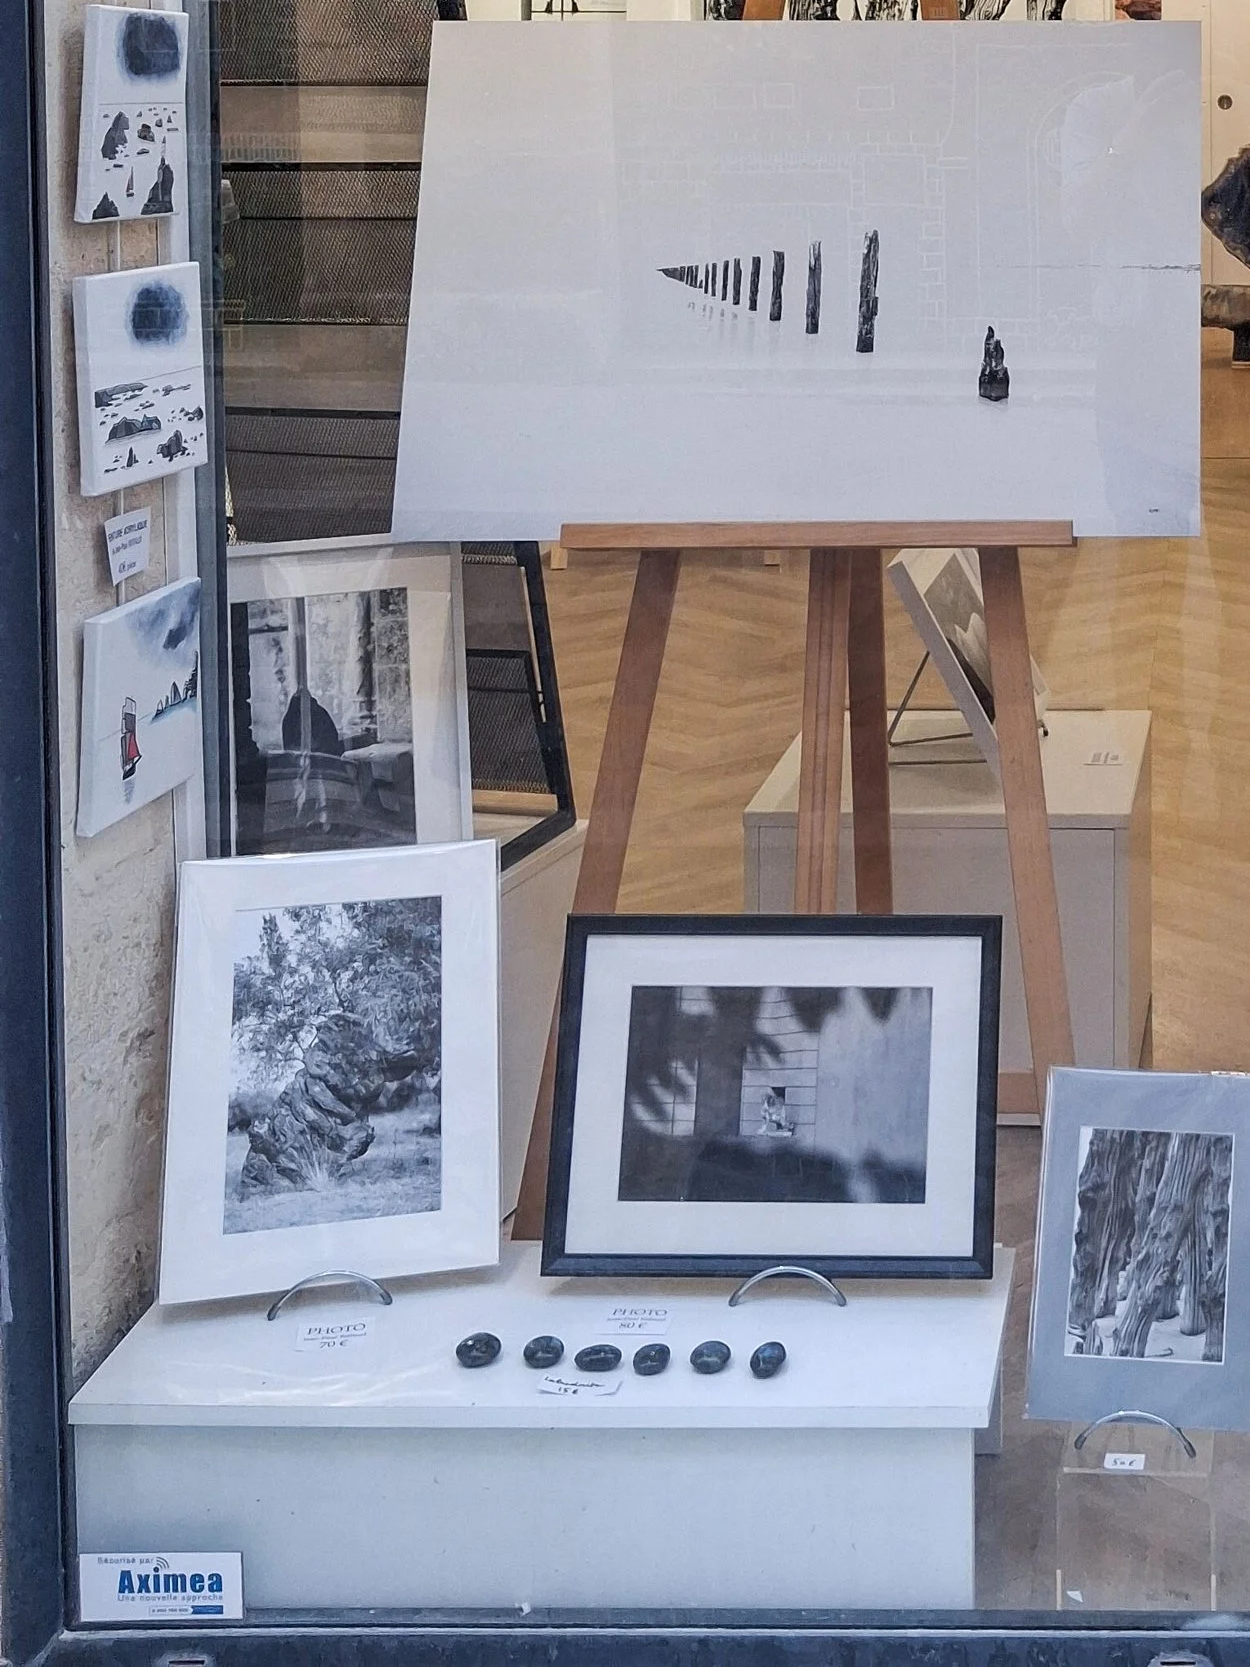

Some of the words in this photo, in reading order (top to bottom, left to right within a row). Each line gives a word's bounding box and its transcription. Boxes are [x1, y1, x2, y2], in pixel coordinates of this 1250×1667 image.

[613, 1308, 668, 1316] PHOTO
[307, 1323, 366, 1335] PHOTO
[320, 1340, 336, 1349] 70
[139, 1557, 154, 1565] par
[118, 1566, 223, 1594] Aximea
[117, 1594, 136, 1602] Une
[139, 1593, 178, 1602] nouvelle
[181, 1594, 223, 1603] approche
